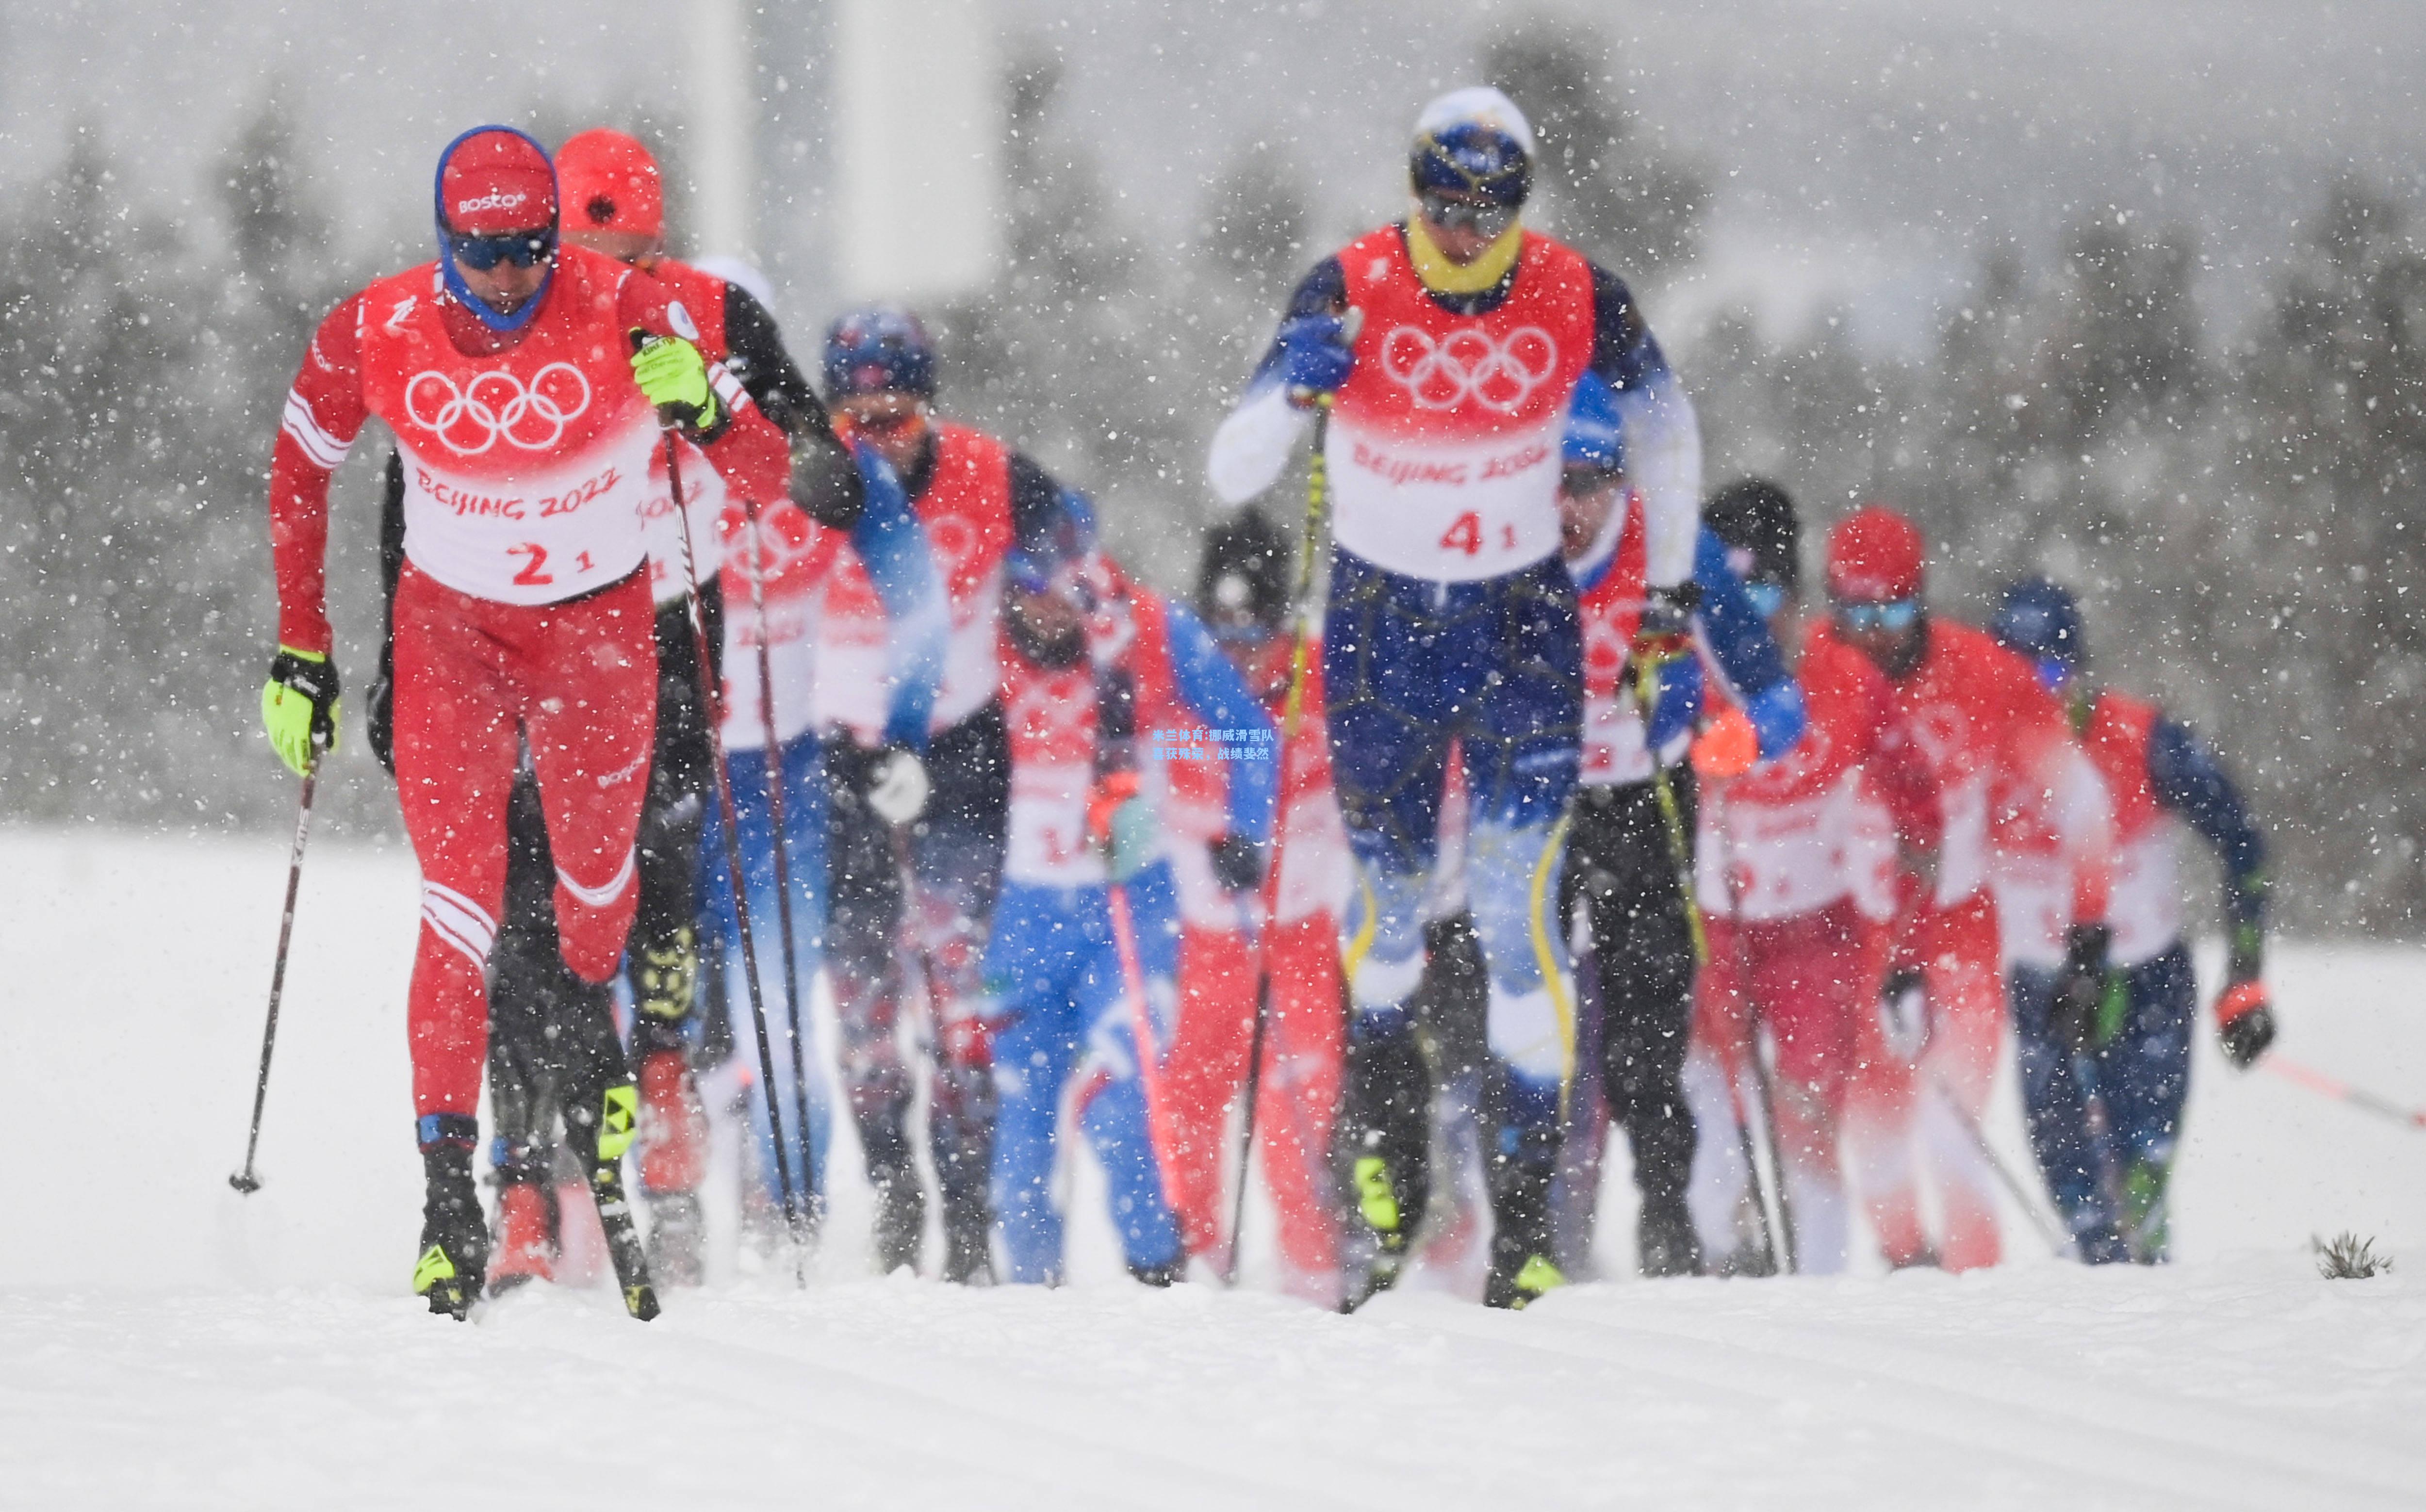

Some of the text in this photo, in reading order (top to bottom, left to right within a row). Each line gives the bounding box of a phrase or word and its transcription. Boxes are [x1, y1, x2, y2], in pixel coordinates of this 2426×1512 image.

[416, 466, 624, 520] BEIJING 2022
[1439, 510, 1518, 556] 4 1
[506, 541, 596, 586] 2 1
